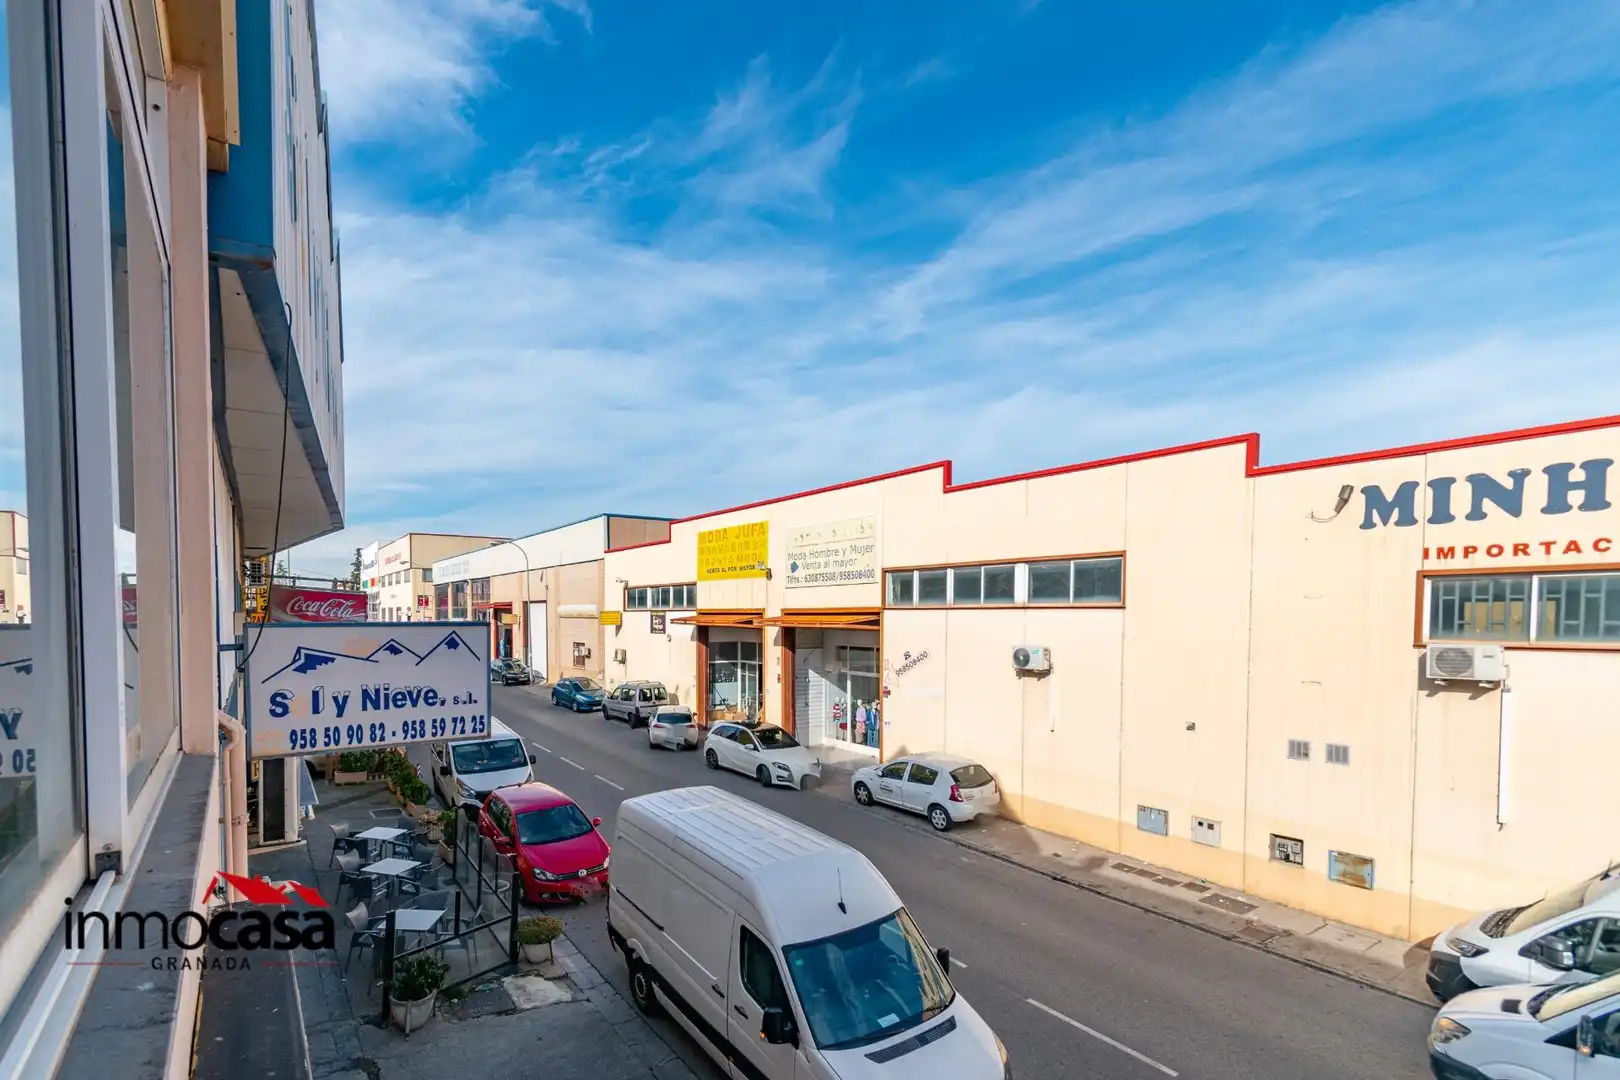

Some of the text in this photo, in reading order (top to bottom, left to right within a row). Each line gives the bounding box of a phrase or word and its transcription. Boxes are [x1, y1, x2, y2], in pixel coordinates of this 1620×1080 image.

[1359, 458, 1614, 530] MINH
[699, 522, 766, 545] MODA JUFA
[787, 543, 875, 561] Moda Hombre y Mujer
[1423, 537, 1613, 560] IMPORTAC
[801, 557, 858, 570] Venta al mayor
[332, 690, 351, 718] y
[289, 728, 317, 750] 958
[324, 726, 340, 747] 50
[347, 724, 363, 746] 90
[370, 722, 386, 743] 82
[402, 720, 425, 740] 958
[431, 717, 447, 738] 59
[451, 715, 466, 735] 72
[471, 714, 486, 734] 25
